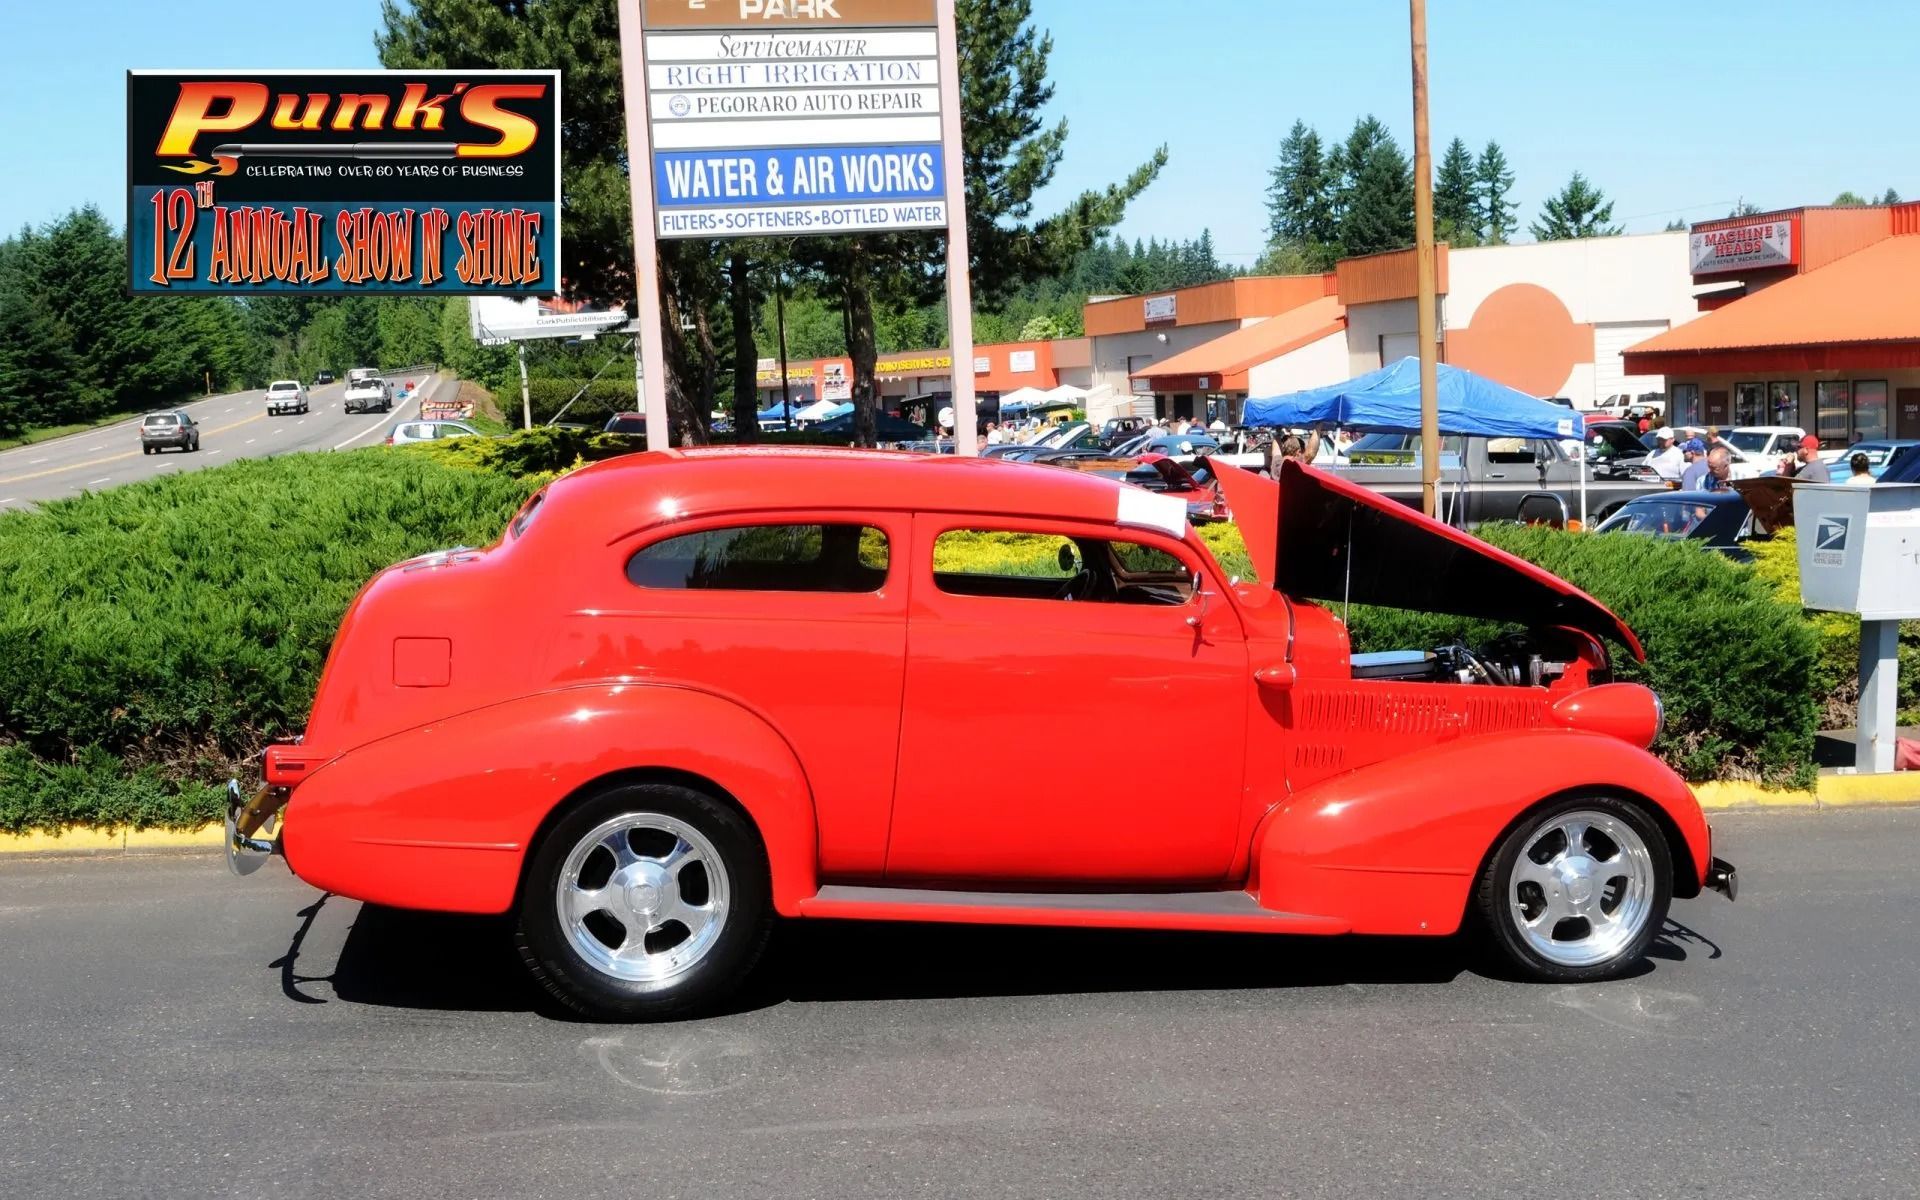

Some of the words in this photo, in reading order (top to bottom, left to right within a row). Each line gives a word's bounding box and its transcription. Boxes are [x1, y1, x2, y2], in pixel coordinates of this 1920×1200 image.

[667, 65, 751, 87] RIGHT
[765, 62, 921, 84] IRRIGATION
[697, 95, 798, 114] PEGORARO
[803, 94, 853, 112] AUTO
[858, 92, 924, 110] REPAIR
[665, 158, 758, 198] WATER
[766, 157, 784, 196] &
[793, 156, 836, 195] AIR
[841, 153, 935, 193] WORKS
[894, 206, 942, 224] WATER
[1705, 225, 1773, 246] MACHINE
[1715, 241, 1762, 257] HEADS
